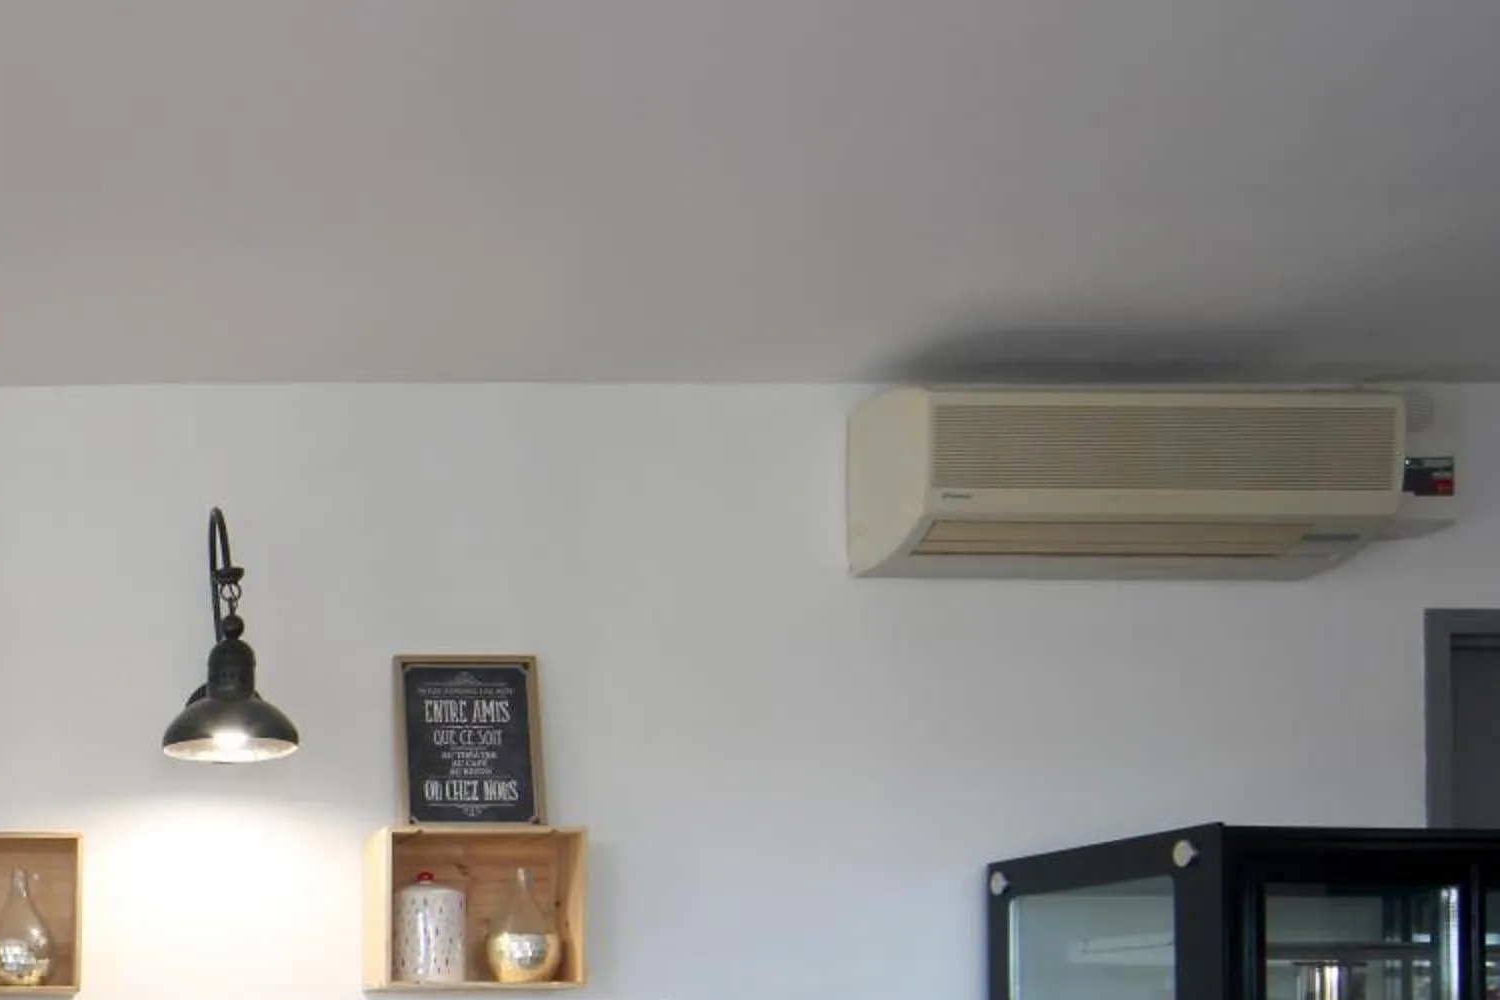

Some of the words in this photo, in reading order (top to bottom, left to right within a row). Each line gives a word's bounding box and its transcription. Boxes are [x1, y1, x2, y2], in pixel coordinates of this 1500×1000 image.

[424, 699, 467, 723] ENTRE
[472, 699, 511, 723] AMIS
[433, 730, 457, 745] QUE
[459, 730, 476, 745] CE
[478, 730, 503, 745] SOIT
[445, 779, 479, 801] CHEZ
[484, 779, 519, 801] NOUS
